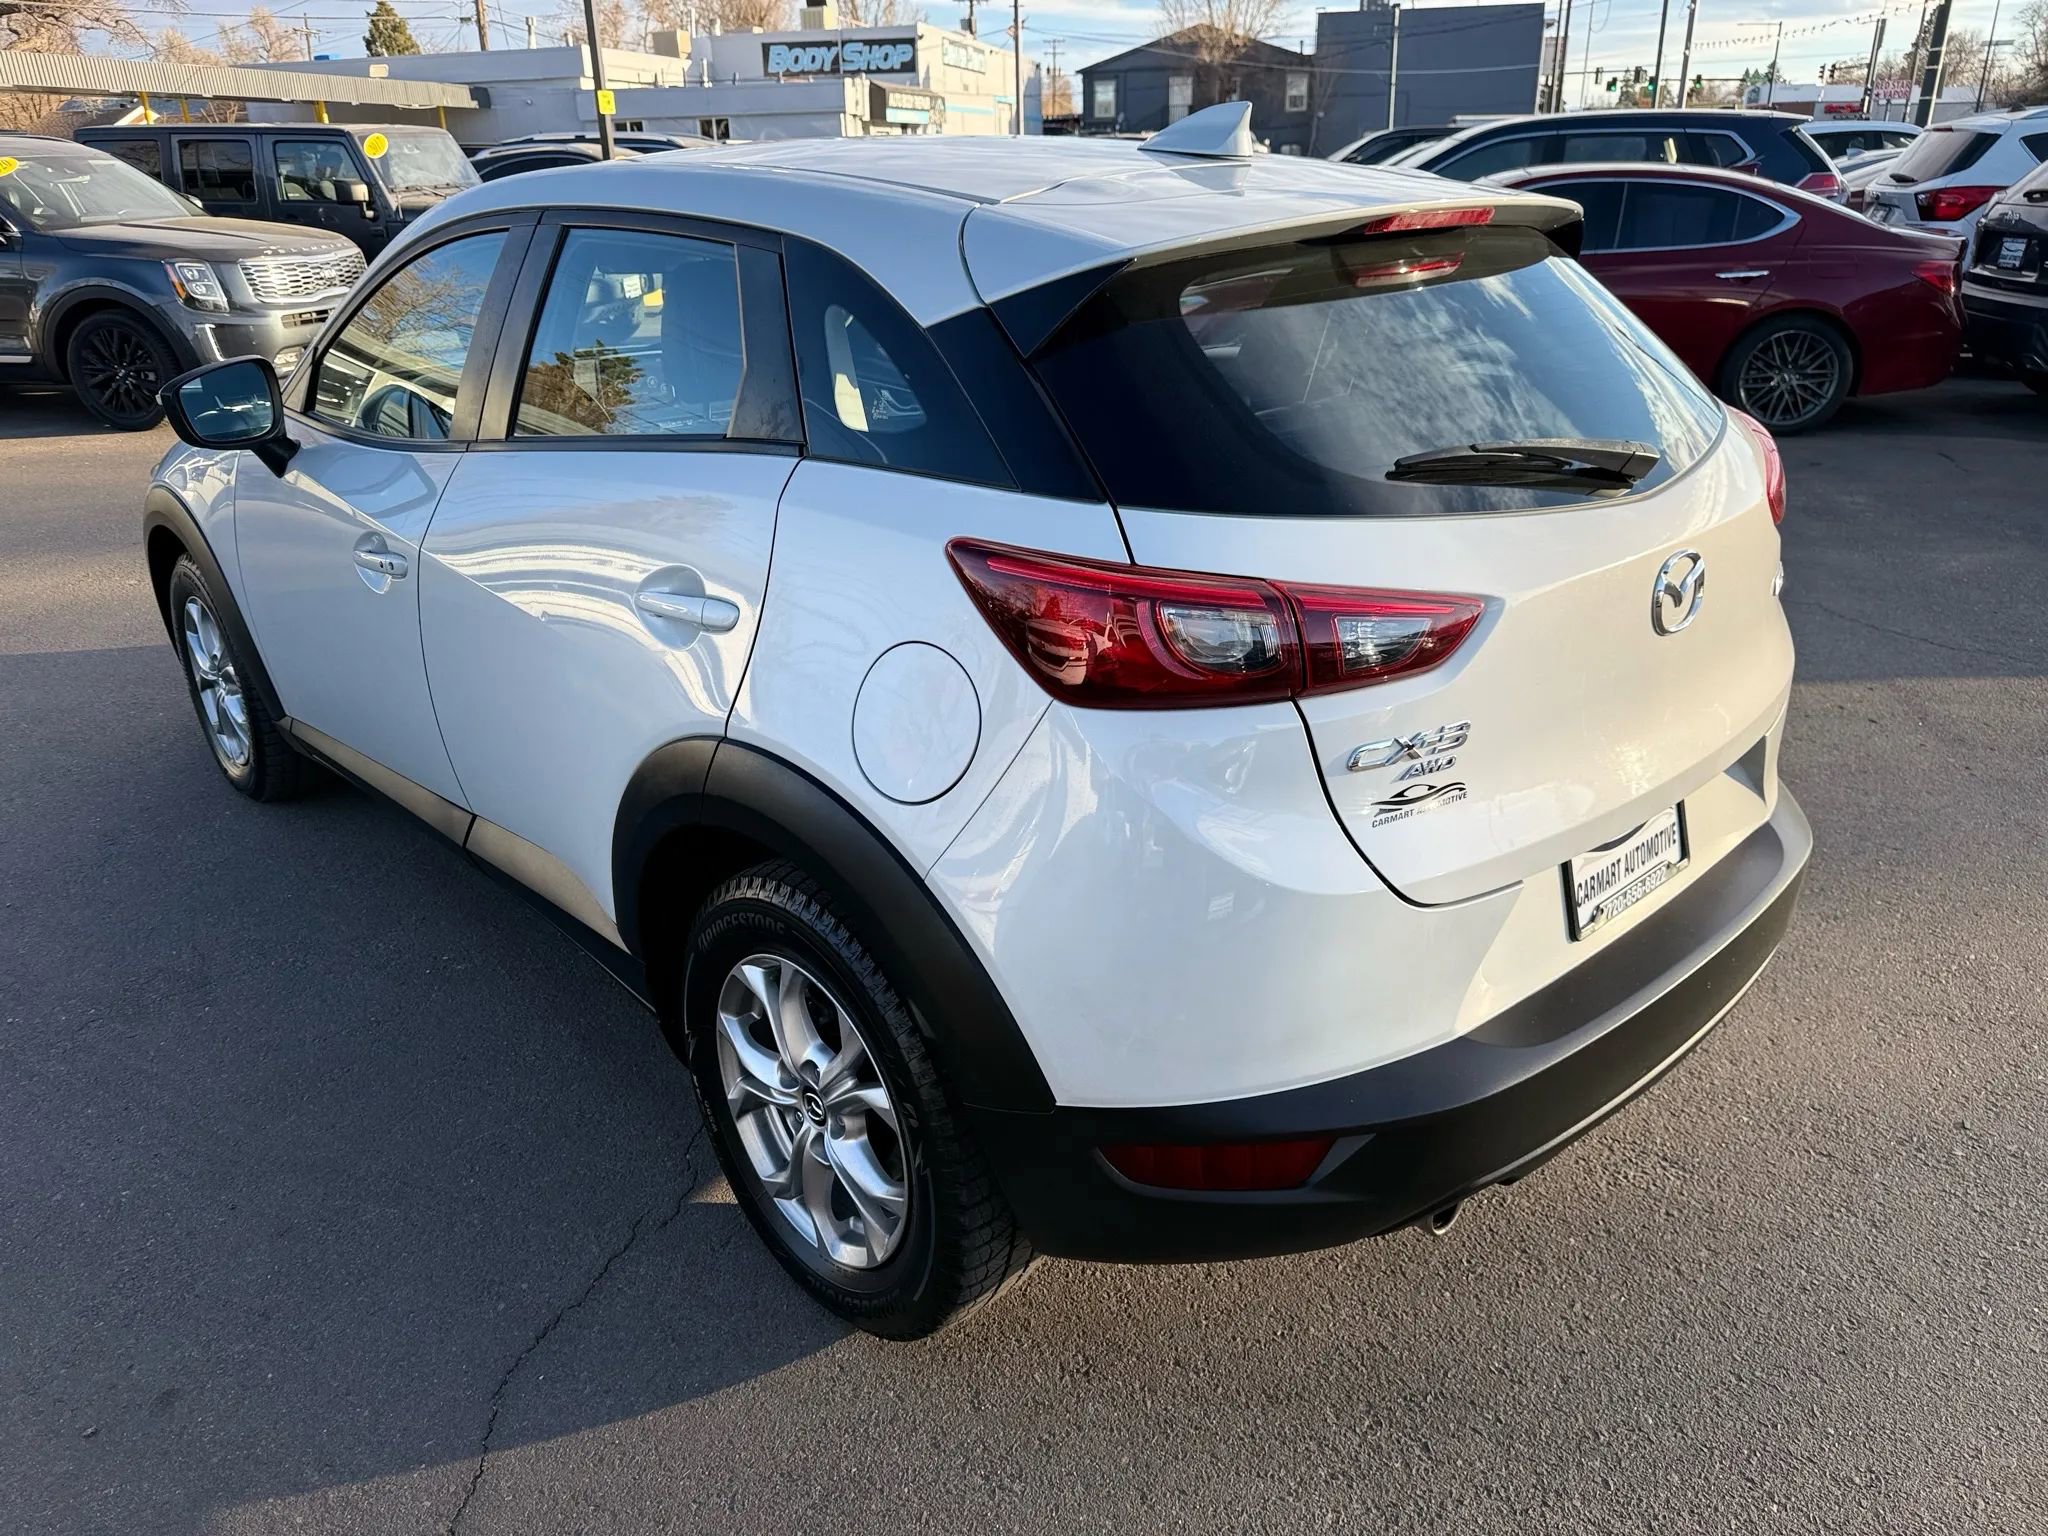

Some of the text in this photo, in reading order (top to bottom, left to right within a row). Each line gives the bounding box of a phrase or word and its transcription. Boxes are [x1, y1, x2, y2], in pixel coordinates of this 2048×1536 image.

[768, 45, 839, 73] BODY
[842, 42, 913, 71] SHOP
[1875, 79, 1912, 90] RED STAR
[1347, 720, 1471, 772] CX-3
[1398, 755, 1457, 781] AWD
[1371, 791, 1468, 828] CARMART AMOTIVE
[1576, 822, 1677, 908] CARMART AUTOMOTIVE
[1605, 866, 1665, 920] 720-656-6922
[697, 911, 786, 952] BRIDGESTONE
